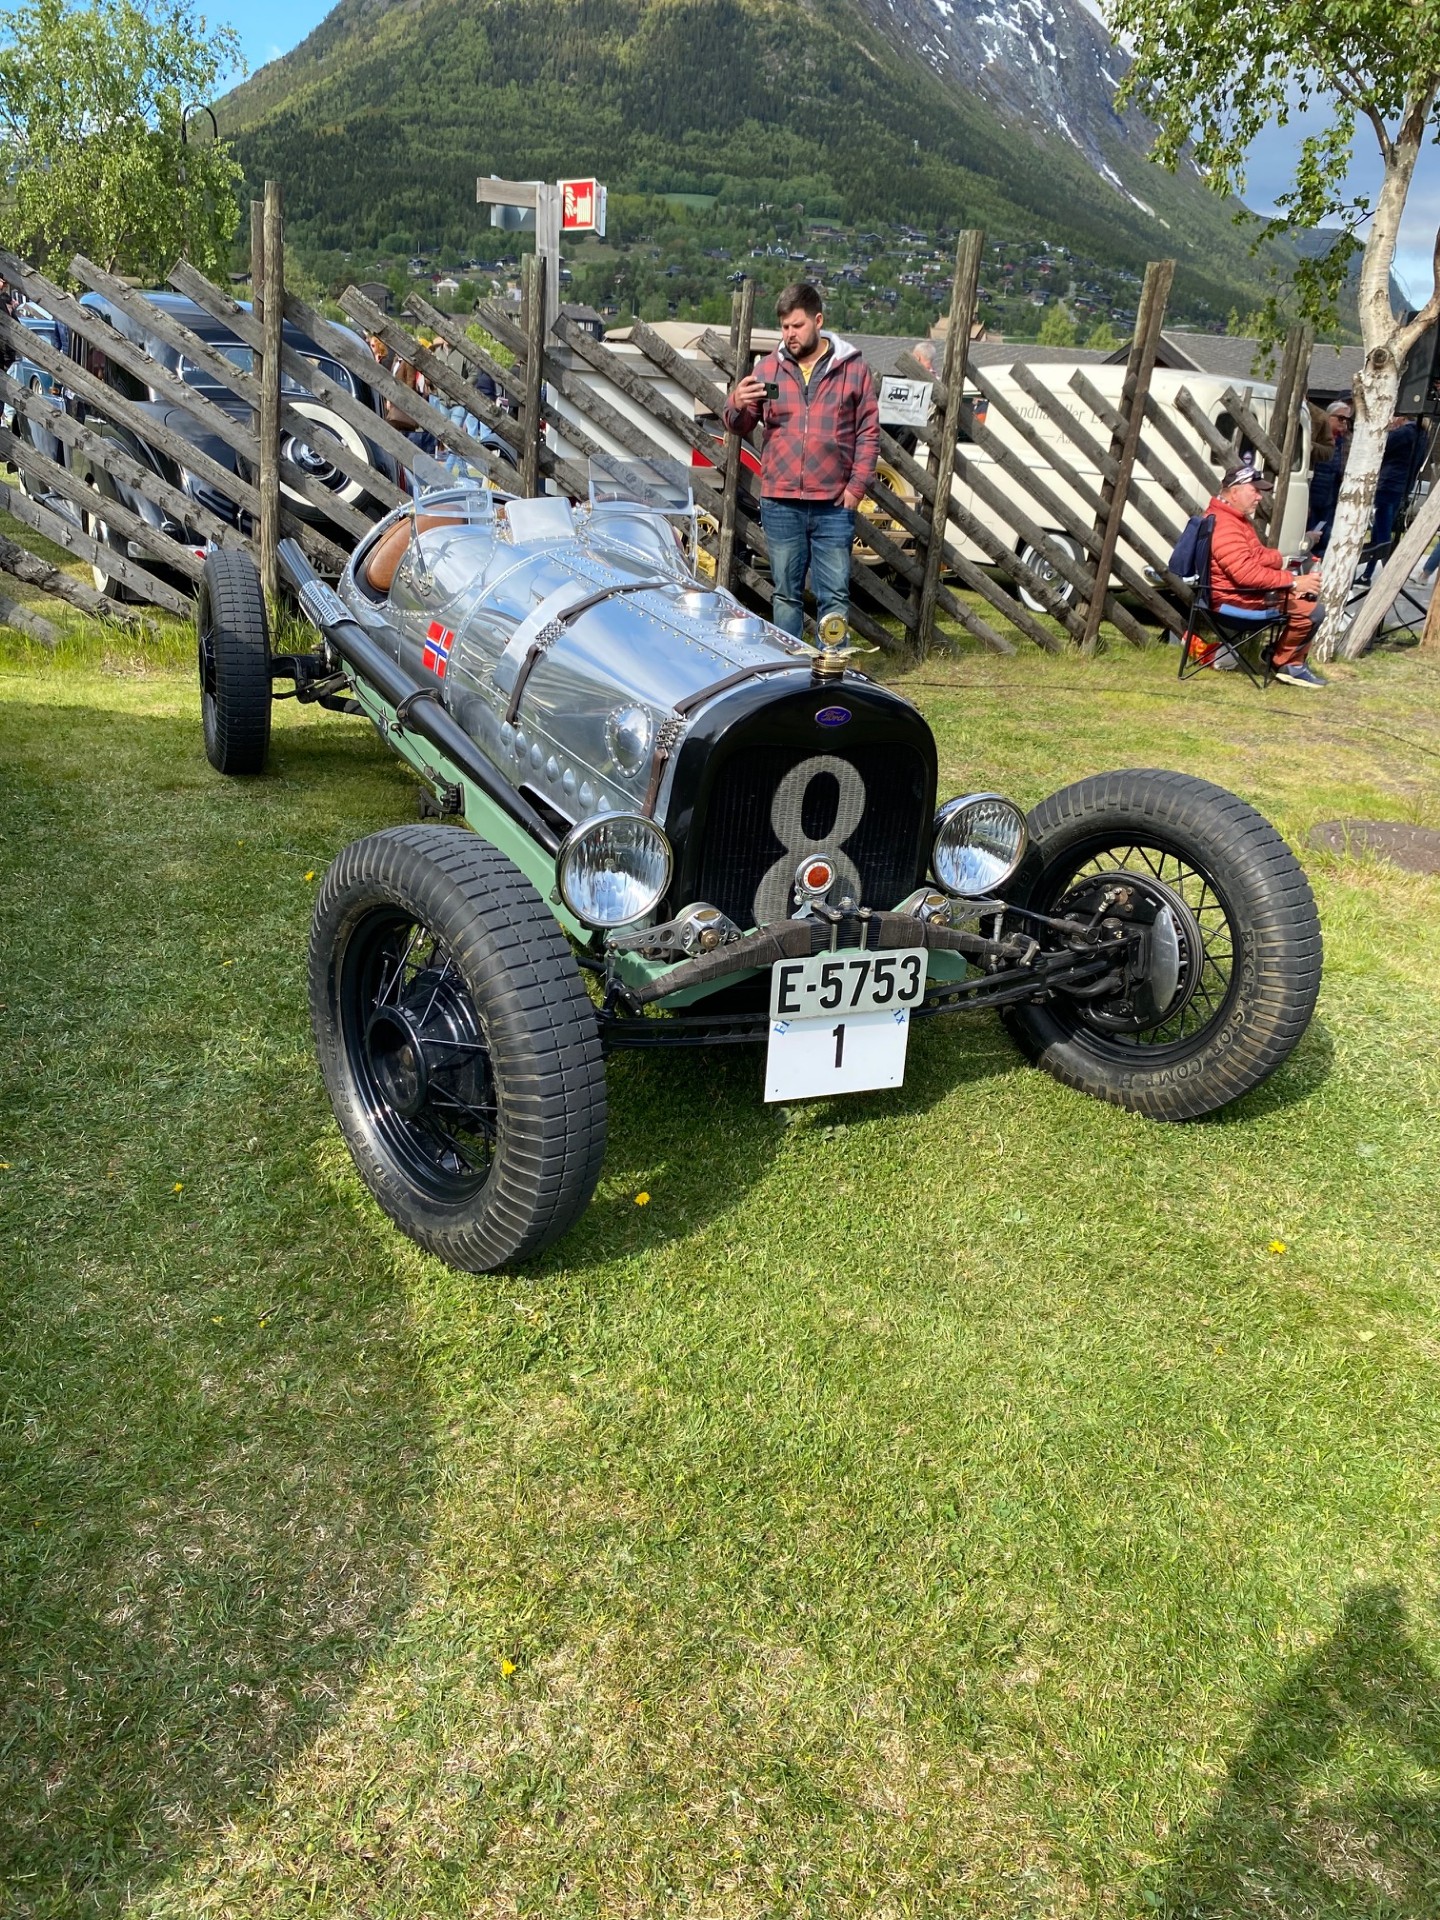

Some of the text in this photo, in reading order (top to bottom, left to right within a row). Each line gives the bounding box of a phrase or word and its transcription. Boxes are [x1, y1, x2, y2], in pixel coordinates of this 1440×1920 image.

[820, 709, 847, 721] Ford
[753, 754, 867, 928] 8
[777, 954, 922, 1014] E-5753
[1211, 928, 1256, 1058] EXCELSIOR
[832, 1023, 846, 1069] 1
